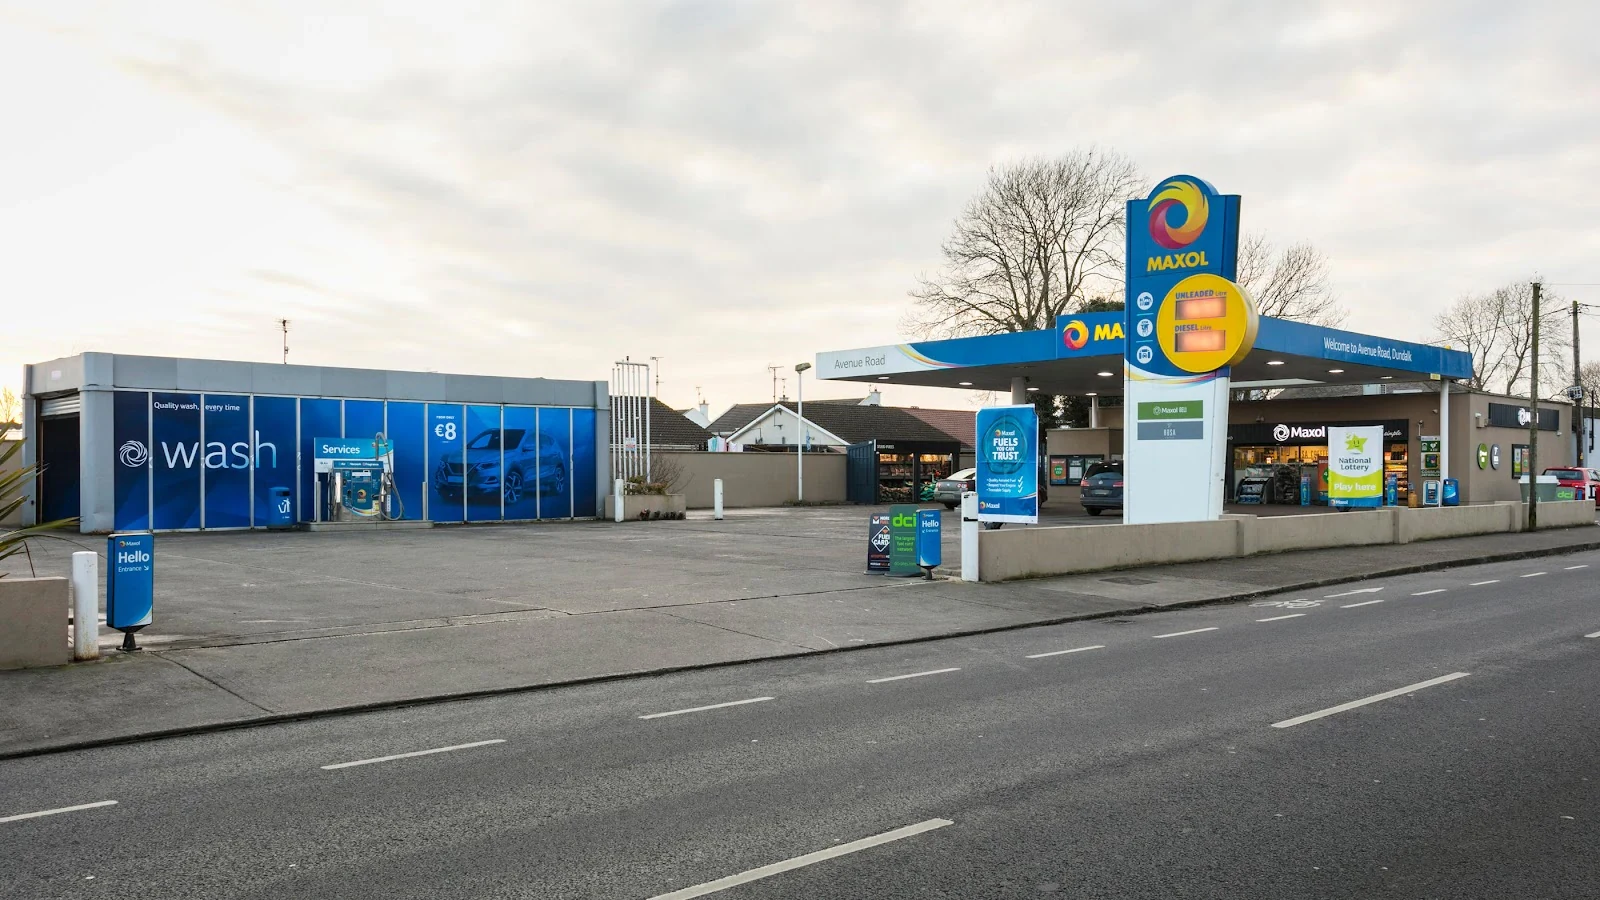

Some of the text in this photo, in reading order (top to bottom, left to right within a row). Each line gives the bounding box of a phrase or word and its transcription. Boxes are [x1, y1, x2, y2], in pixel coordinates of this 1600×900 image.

[1146, 250, 1209, 272] MAXOL
[1175, 289, 1214, 300] UNLEADED
[1093, 322, 1125, 342] MA
[1174, 323, 1199, 332] DIESEL
[1323, 336, 1412, 362] Welcome to Avenue Road, Dundalk
[834, 355, 886, 369] Avenue Road
[154, 401, 241, 412] Quality wash, every time
[1161, 406, 1179, 414] Maxol
[434, 422, 457, 441] €8
[1290, 425, 1326, 438] Maxol
[993, 437, 1018, 447] FUELS
[161, 429, 277, 469] wash
[322, 444, 360, 454] Services
[992, 451, 1019, 460] TRUST
[1340, 463, 1369, 472] Lottery
[1334, 482, 1377, 492] Play here
[892, 512, 917, 528] dci
[921, 519, 939, 528] Hello
[118, 550, 150, 563] Hello
[118, 565, 142, 573] Entrance
